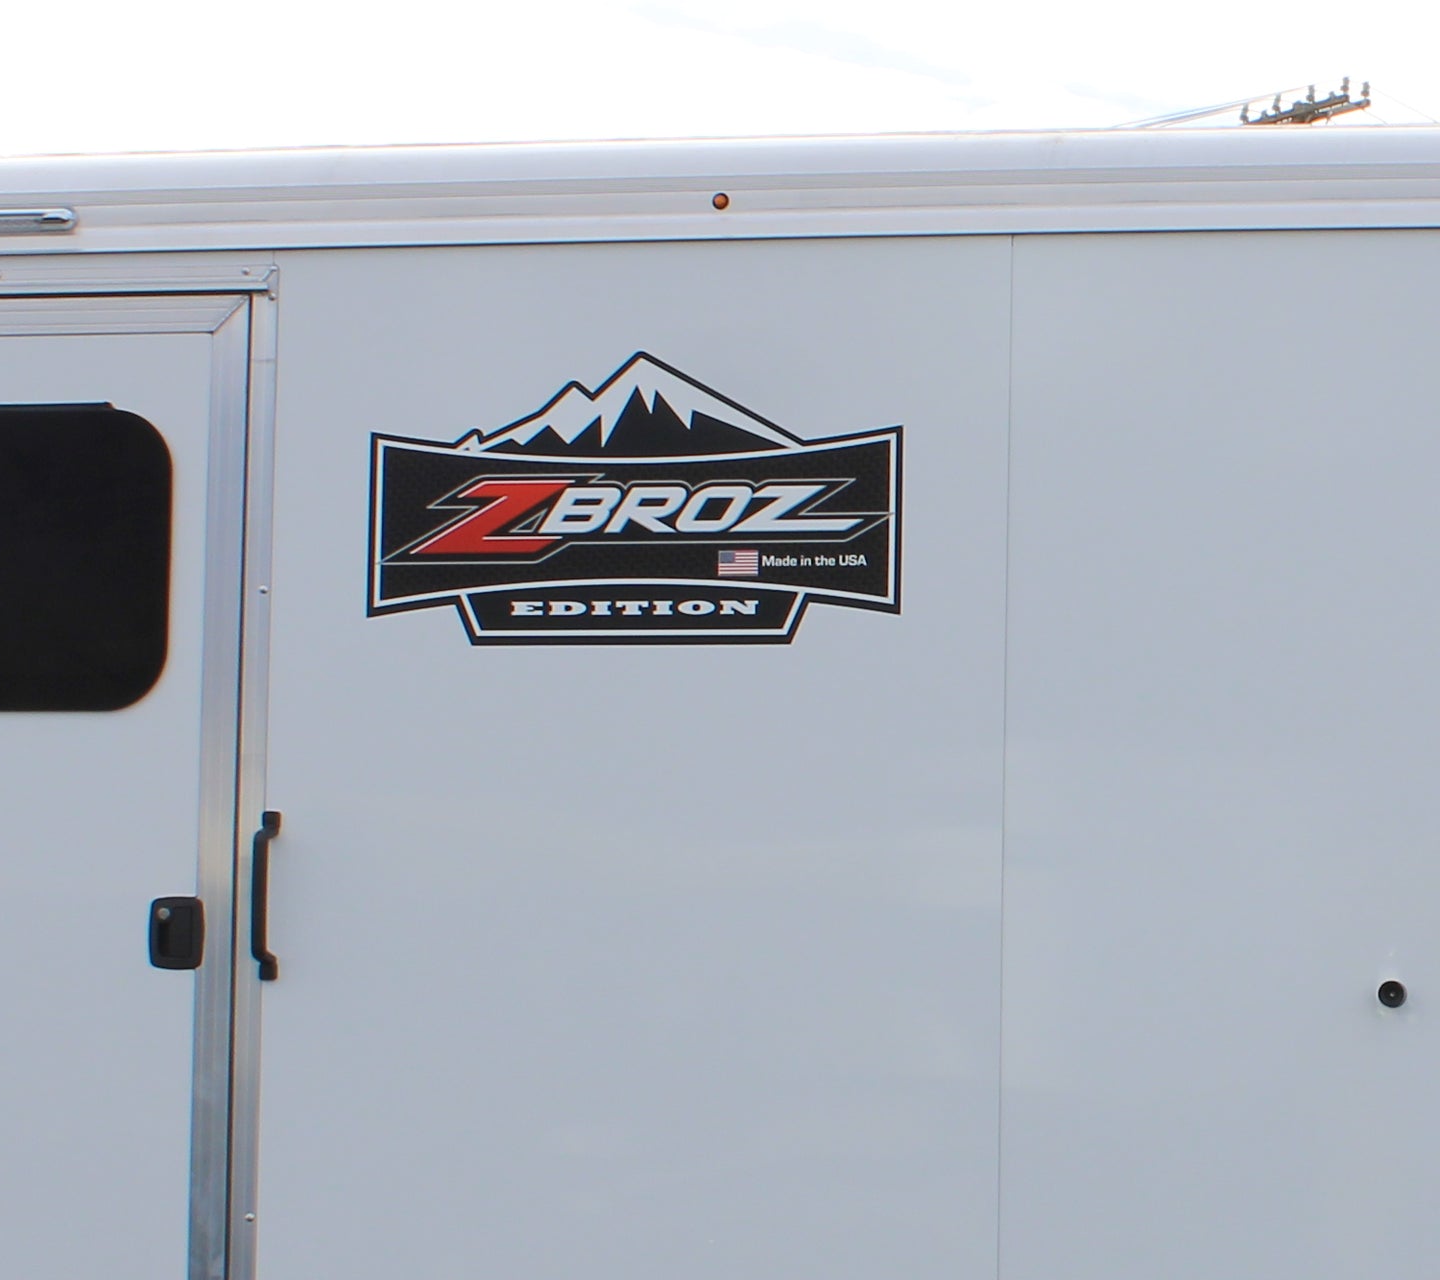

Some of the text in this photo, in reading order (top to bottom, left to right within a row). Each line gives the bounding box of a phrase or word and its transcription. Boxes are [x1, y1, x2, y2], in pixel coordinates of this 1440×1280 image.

[410, 479, 864, 554] ZBROZ
[761, 553, 868, 567] Made in the USA
[510, 599, 760, 617] EDITION
